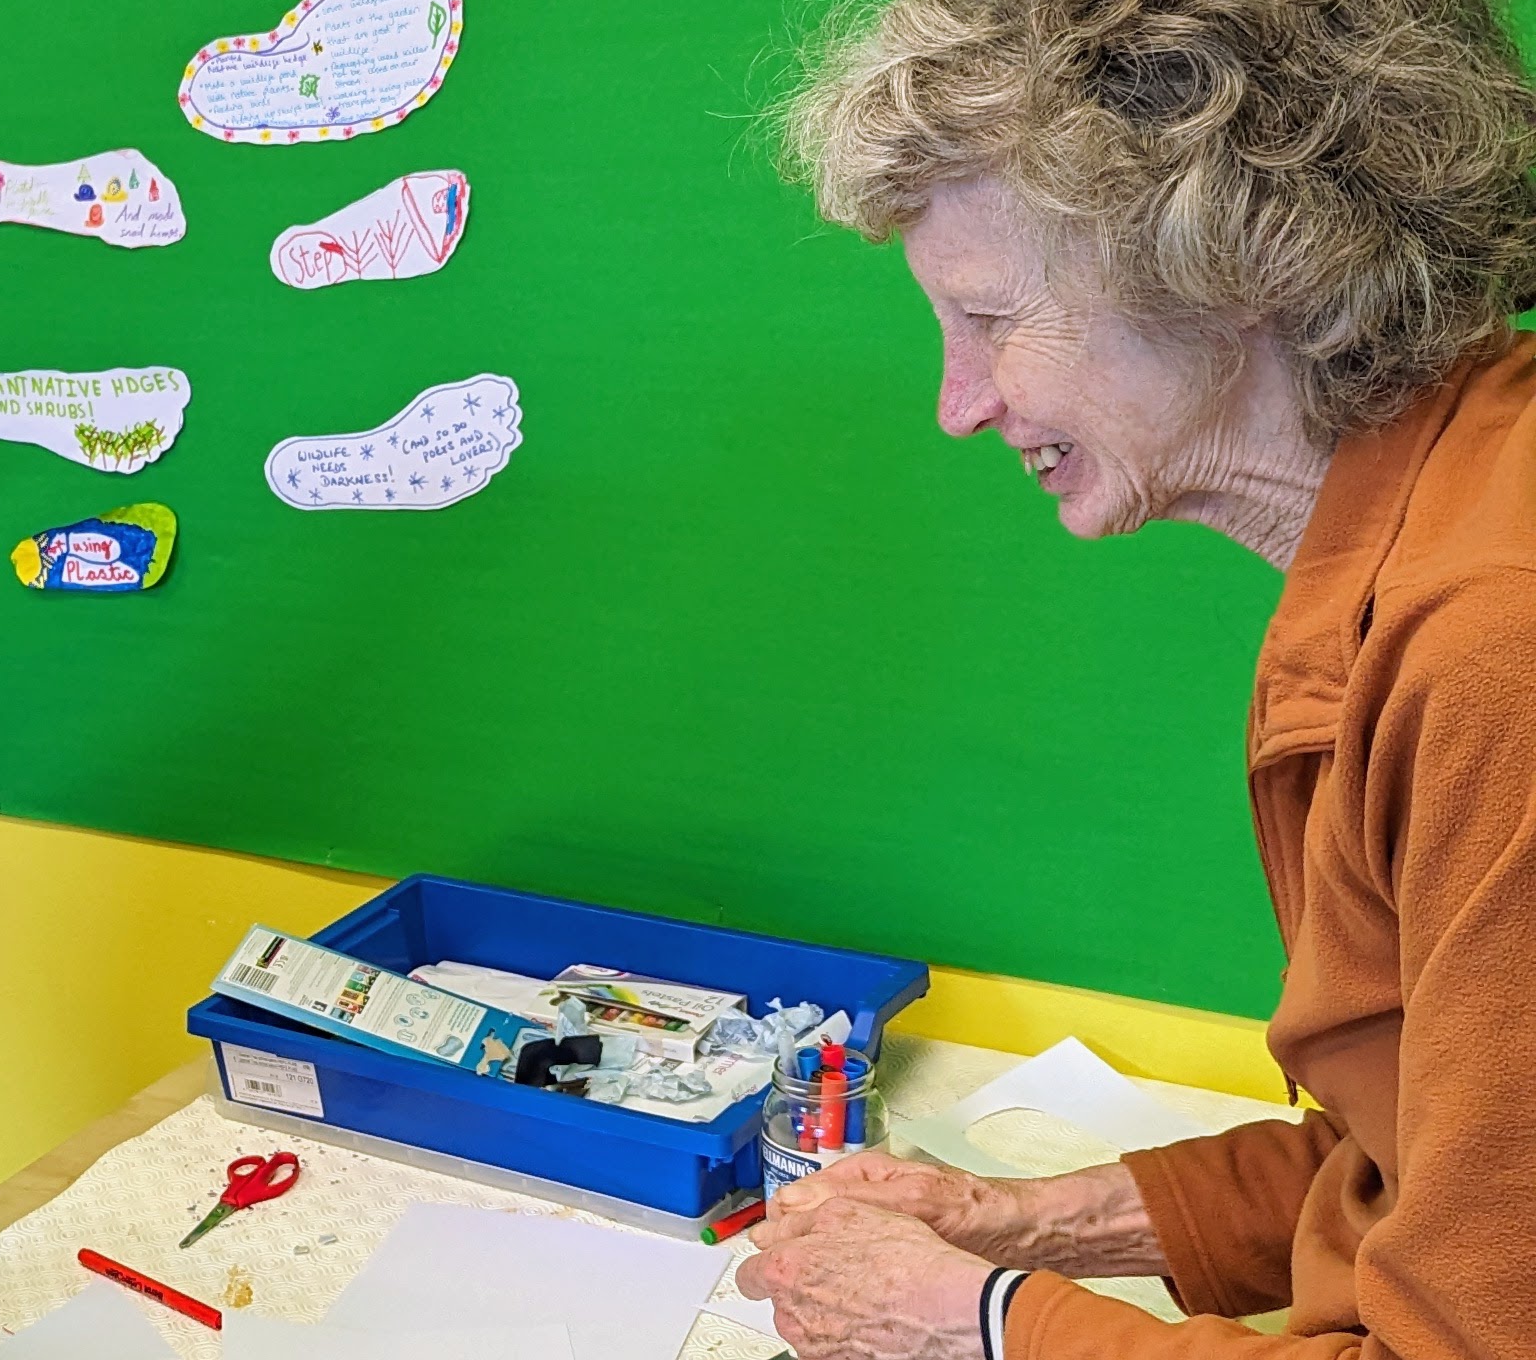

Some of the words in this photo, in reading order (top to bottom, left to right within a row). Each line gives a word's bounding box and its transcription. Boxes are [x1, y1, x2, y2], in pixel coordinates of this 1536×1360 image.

[115, 204, 142, 223] And
[30, 376, 102, 398] NATIVE
[26, 400, 95, 423] SHRUBS!
[435, 429, 449, 441] SO
[452, 421, 468, 435] DO
[460, 429, 484, 447] AND
[297, 446, 352, 462] WILDLIFE
[312, 462, 348, 473] NEEDS
[319, 464, 395, 487] DARKNESS!
[72, 537, 113, 560] using
